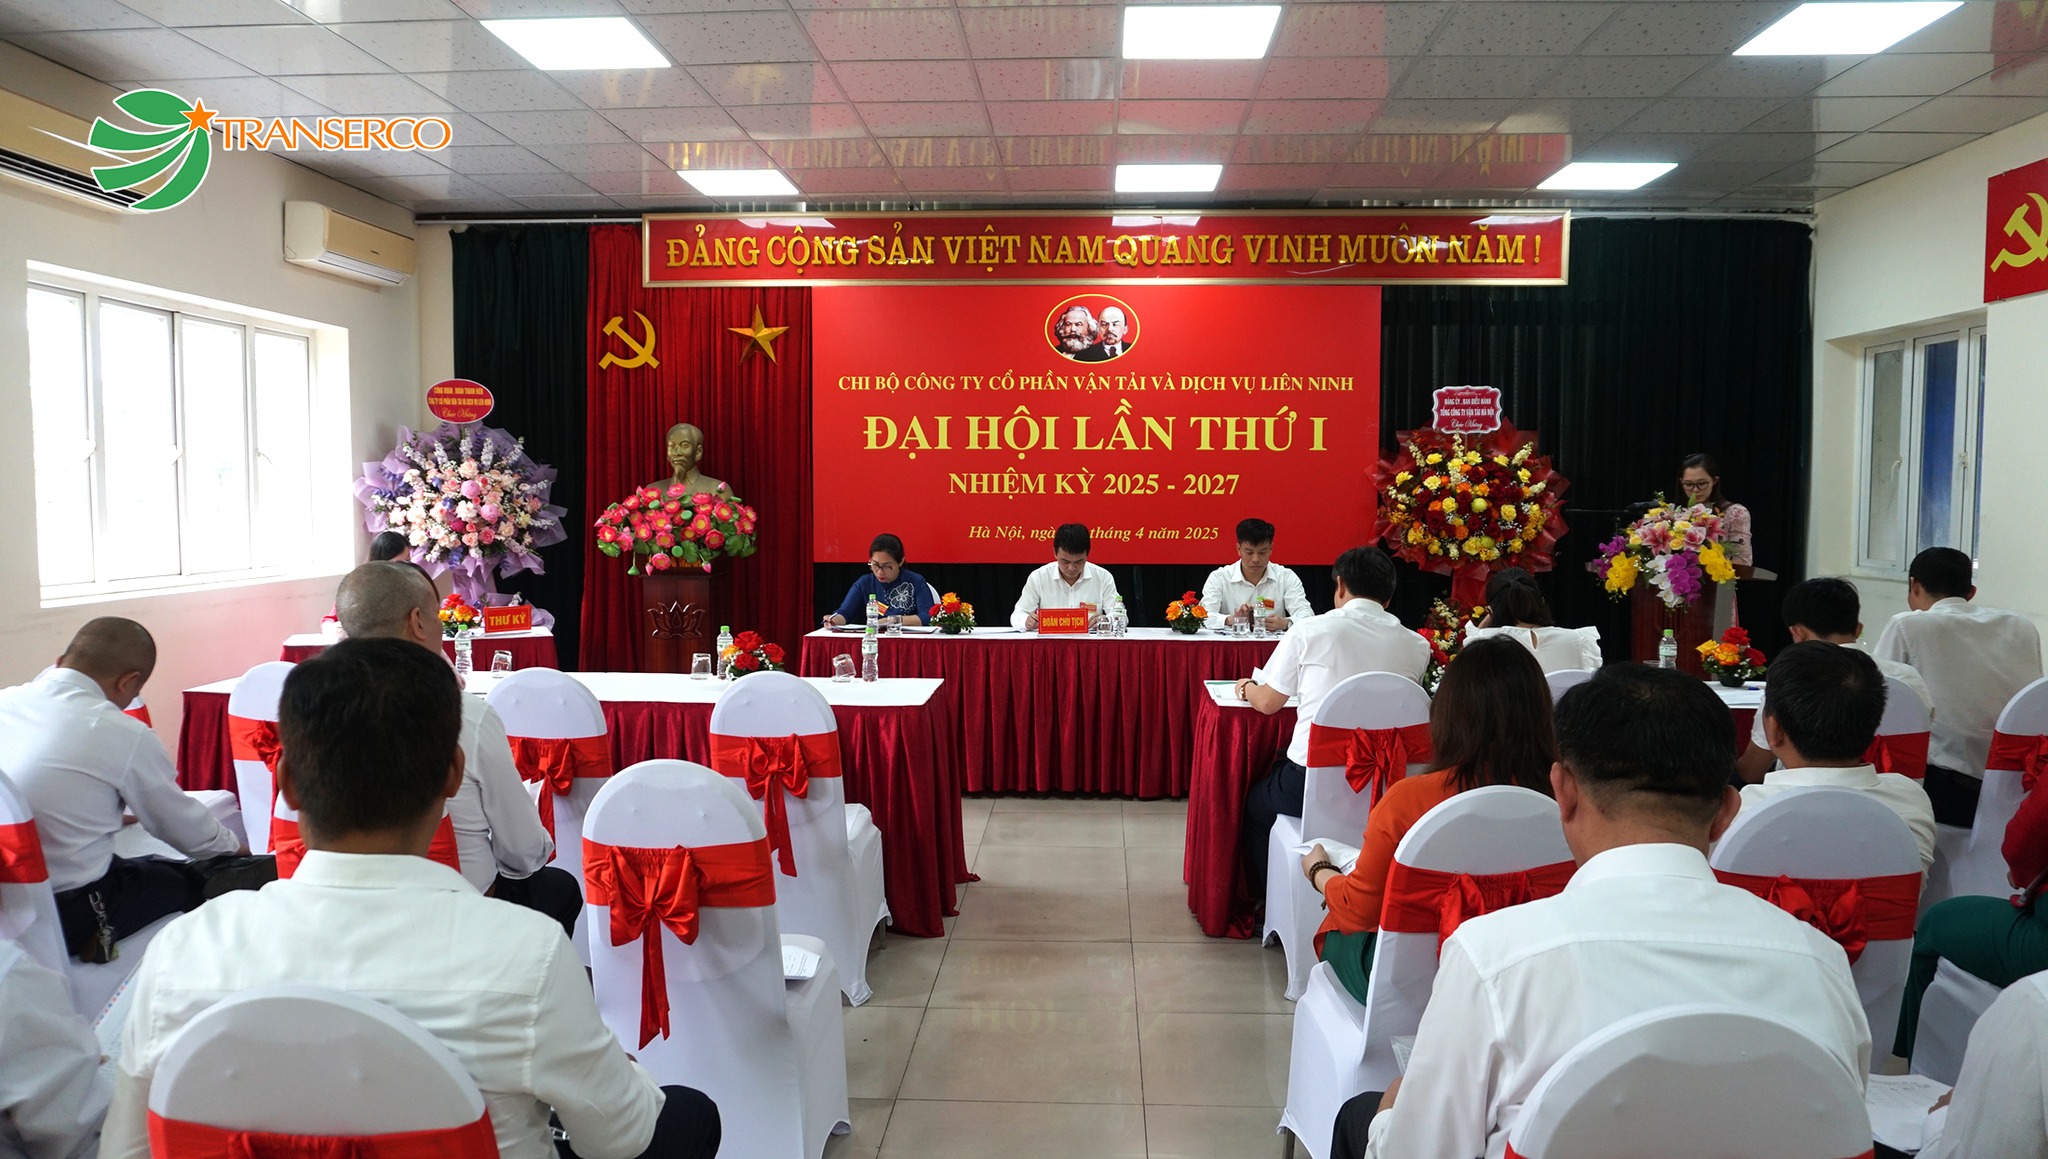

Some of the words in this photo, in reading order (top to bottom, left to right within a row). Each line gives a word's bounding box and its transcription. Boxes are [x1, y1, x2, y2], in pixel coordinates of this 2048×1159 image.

[666, 223, 760, 267] ĐẢNG
[767, 225, 859, 274] CỘNG
[868, 221, 935, 265] SẢN
[942, 224, 1021, 272] VIỆT
[1028, 235, 1106, 264] NAM
[1113, 234, 1234, 267] QUANG
[1243, 234, 1331, 264] VINH
[1338, 222, 1439, 264] MUÔN
[1446, 224, 1525, 264] NĂM
[838, 375, 870, 391] CHI
[875, 372, 899, 395] BỘ
[904, 372, 955, 391] CÔNG
[960, 376, 984, 390] TY
[989, 368, 1015, 391] CỔ
[1020, 369, 1068, 391] PHẦN
[1073, 371, 1111, 395] VẬN
[1115, 371, 1146, 391] TẢI
[1150, 371, 1176, 391] VÀ
[1181, 375, 1227, 395] DỊCH
[1231, 376, 1256, 395] VỤ
[1261, 372, 1304, 391] LIÊN
[1308, 376, 1354, 391] NINH
[863, 415, 952, 460] ĐẠI
[966, 404, 1060, 460] HỘI
[1073, 397, 1177, 451] LẦN
[1190, 405, 1298, 451] THỨ
[1309, 417, 1329, 451] I
[949, 467, 1047, 500] NHIỆM
[1055, 467, 1096, 495] KỲ
[1103, 473, 1160, 495] 2025
[1184, 473, 1240, 495] 2027
[968, 525, 990, 539] Hà
[994, 525, 1026, 541] Nội,
[1030, 526, 1055, 541] ngà
[1089, 526, 1131, 542] tháng
[1135, 526, 1144, 539] 4
[1148, 526, 1180, 539] năm
[1184, 526, 1219, 540] 2025
[489, 613, 511, 626] THƯ
[512, 611, 526, 625] KÝ
[1042, 615, 1058, 627] ĐOÀN
[1059, 613, 1071, 627] CHỦ
[1071, 616, 1085, 629] TỊCH
